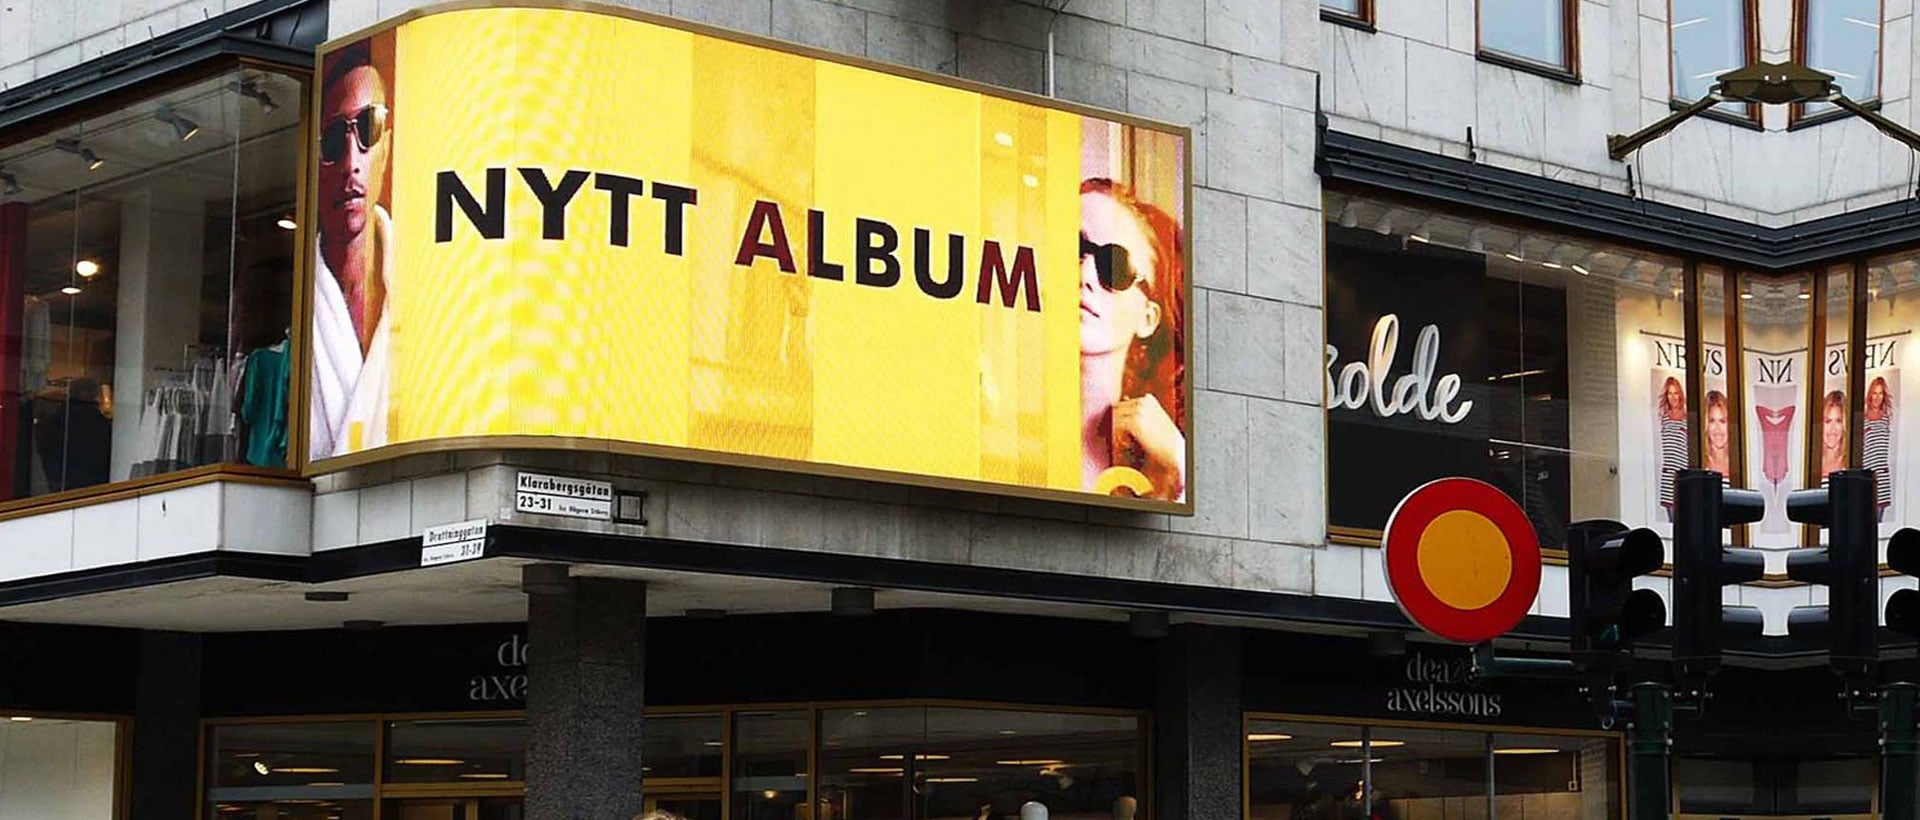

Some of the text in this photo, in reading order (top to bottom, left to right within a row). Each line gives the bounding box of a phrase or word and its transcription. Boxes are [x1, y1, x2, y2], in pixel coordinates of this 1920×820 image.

[435, 167, 1042, 313] NYTT ALBUM
[520, 476, 609, 497] Klarabergsgatan
[520, 495, 551, 510] 23-31
[1387, 684, 1501, 716] axelssons
